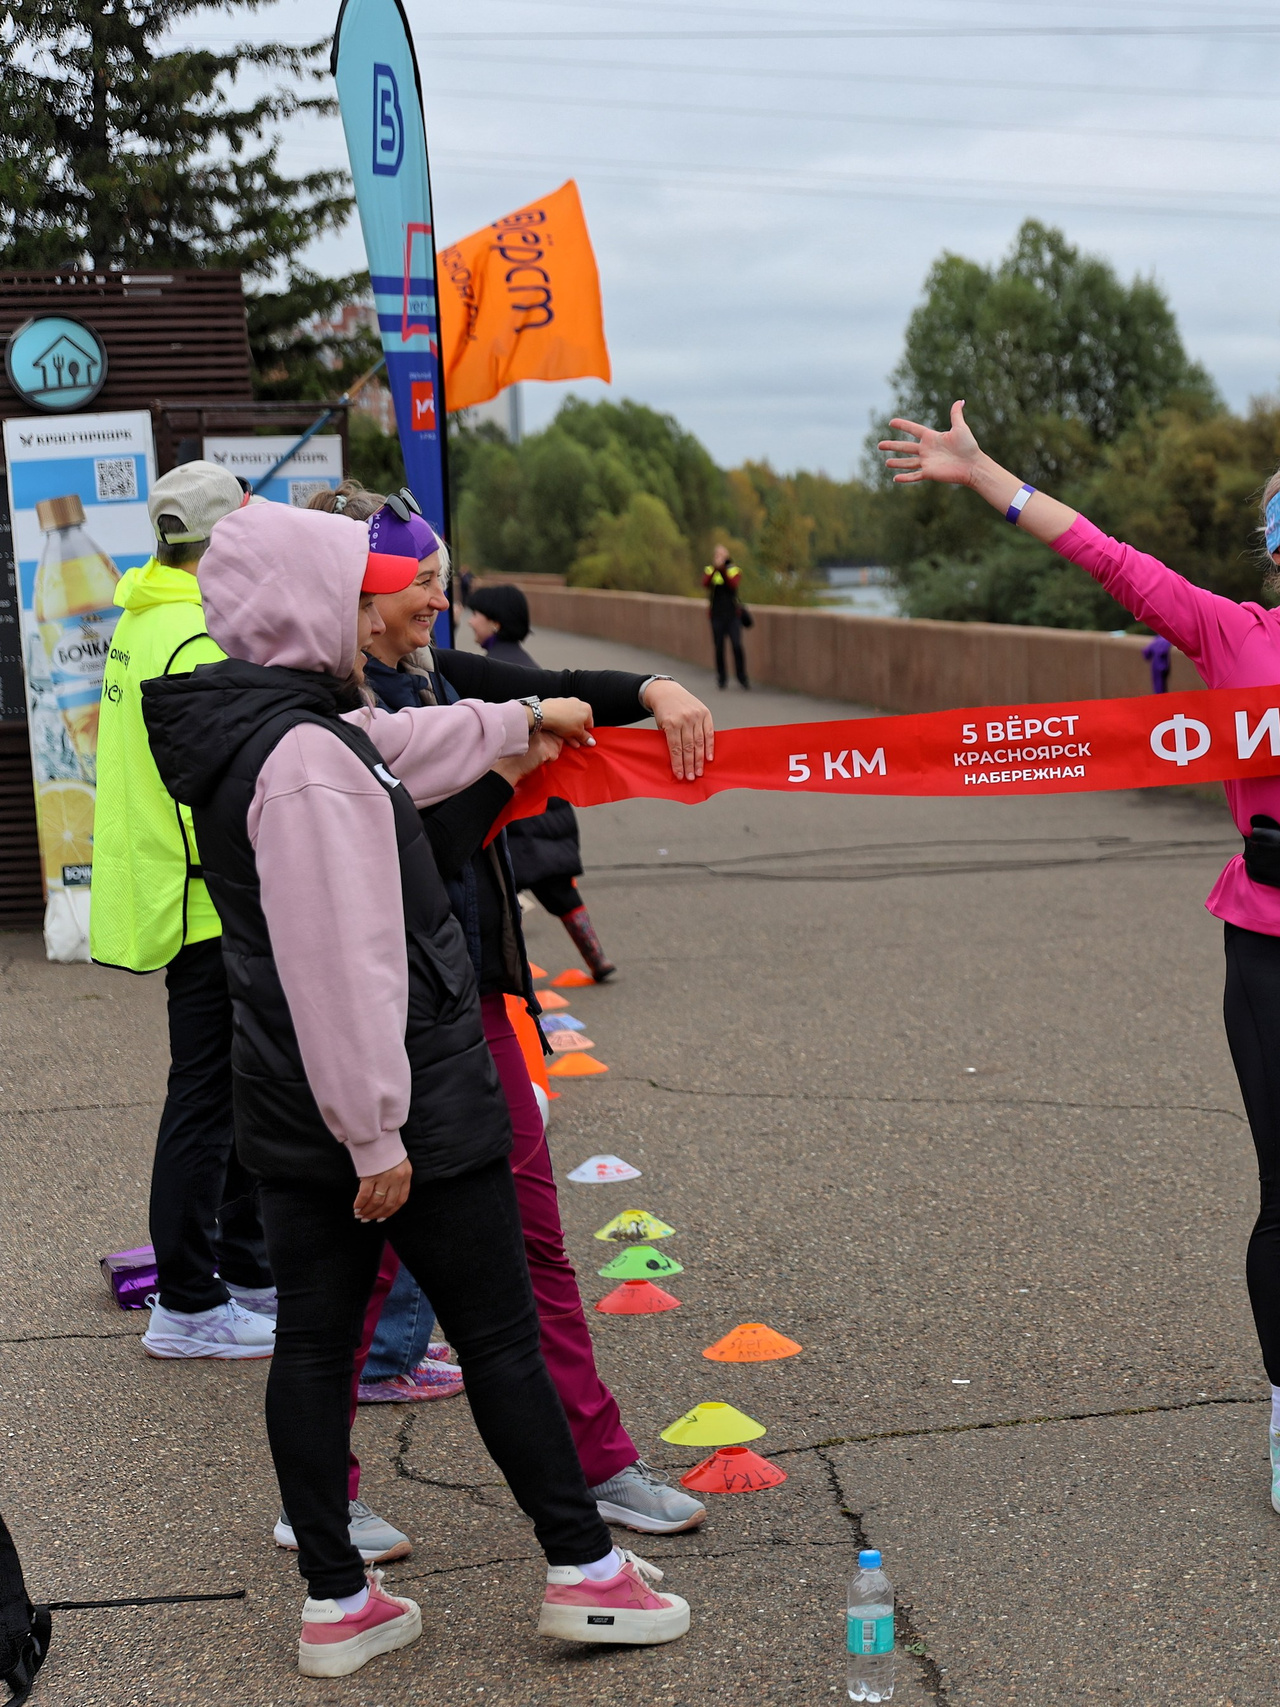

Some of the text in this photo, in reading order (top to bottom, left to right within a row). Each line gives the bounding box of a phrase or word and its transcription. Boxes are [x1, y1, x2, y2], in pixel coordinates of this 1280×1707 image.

[58, 639, 111, 663] БОЧКА
[963, 715, 1081, 744] 5 ВЁРСТ
[788, 748, 886, 782] 5 КМ
[954, 742, 1092, 767] КРАСНОЯРСК
[963, 765, 1085, 785] НАБЕРЕЖНАЯ
